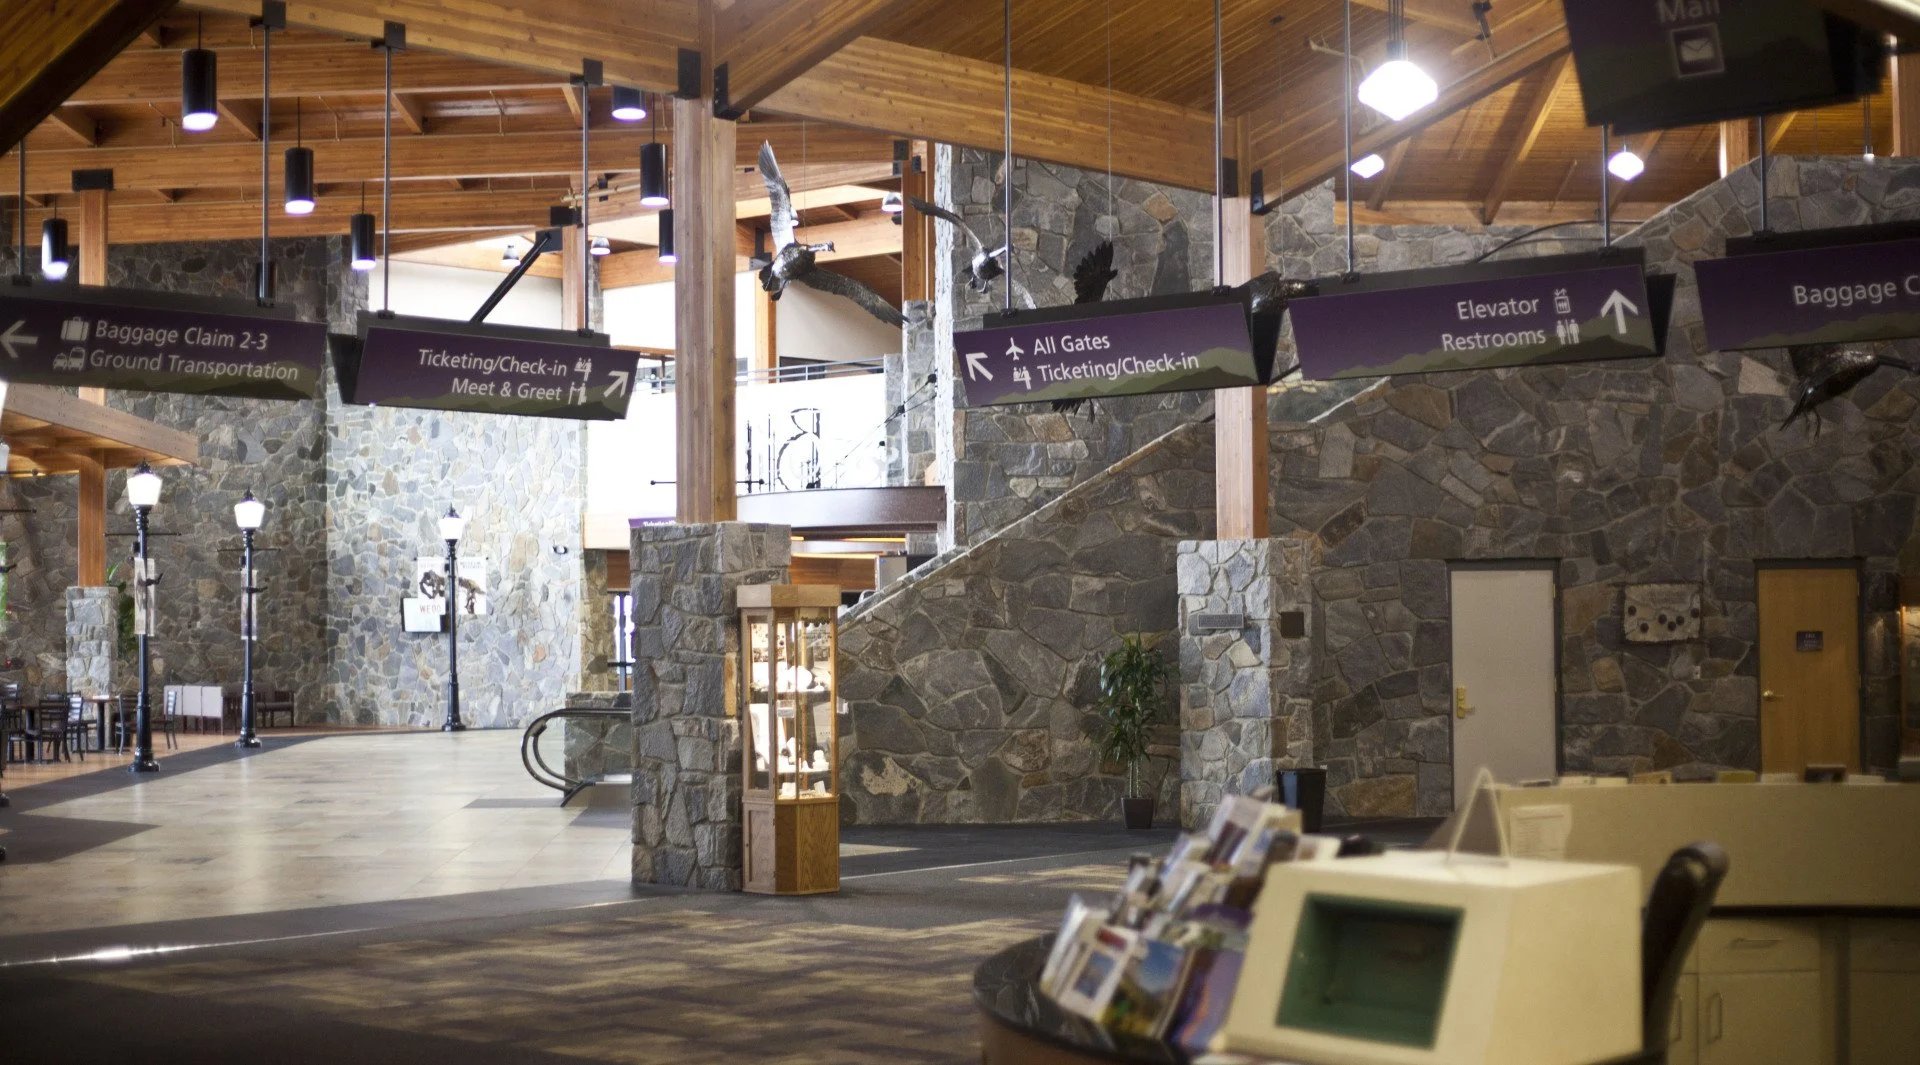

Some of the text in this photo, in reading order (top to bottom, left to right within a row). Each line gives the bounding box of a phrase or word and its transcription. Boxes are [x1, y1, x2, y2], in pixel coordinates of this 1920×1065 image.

[1794, 282, 1897, 308] Baggage
[1457, 298, 1539, 320] Elevator
[95, 319, 268, 350] Baggage Claim 2-3
[1033, 334, 1110, 356] All Gates
[1442, 329, 1547, 351] Restrooms
[90, 349, 298, 380] Ground Transportation
[418, 349, 567, 376] Ticketing/Check-in
[1037, 352, 1199, 382] Ticketing/Check-in
[451, 377, 562, 401] Meet & Greet
